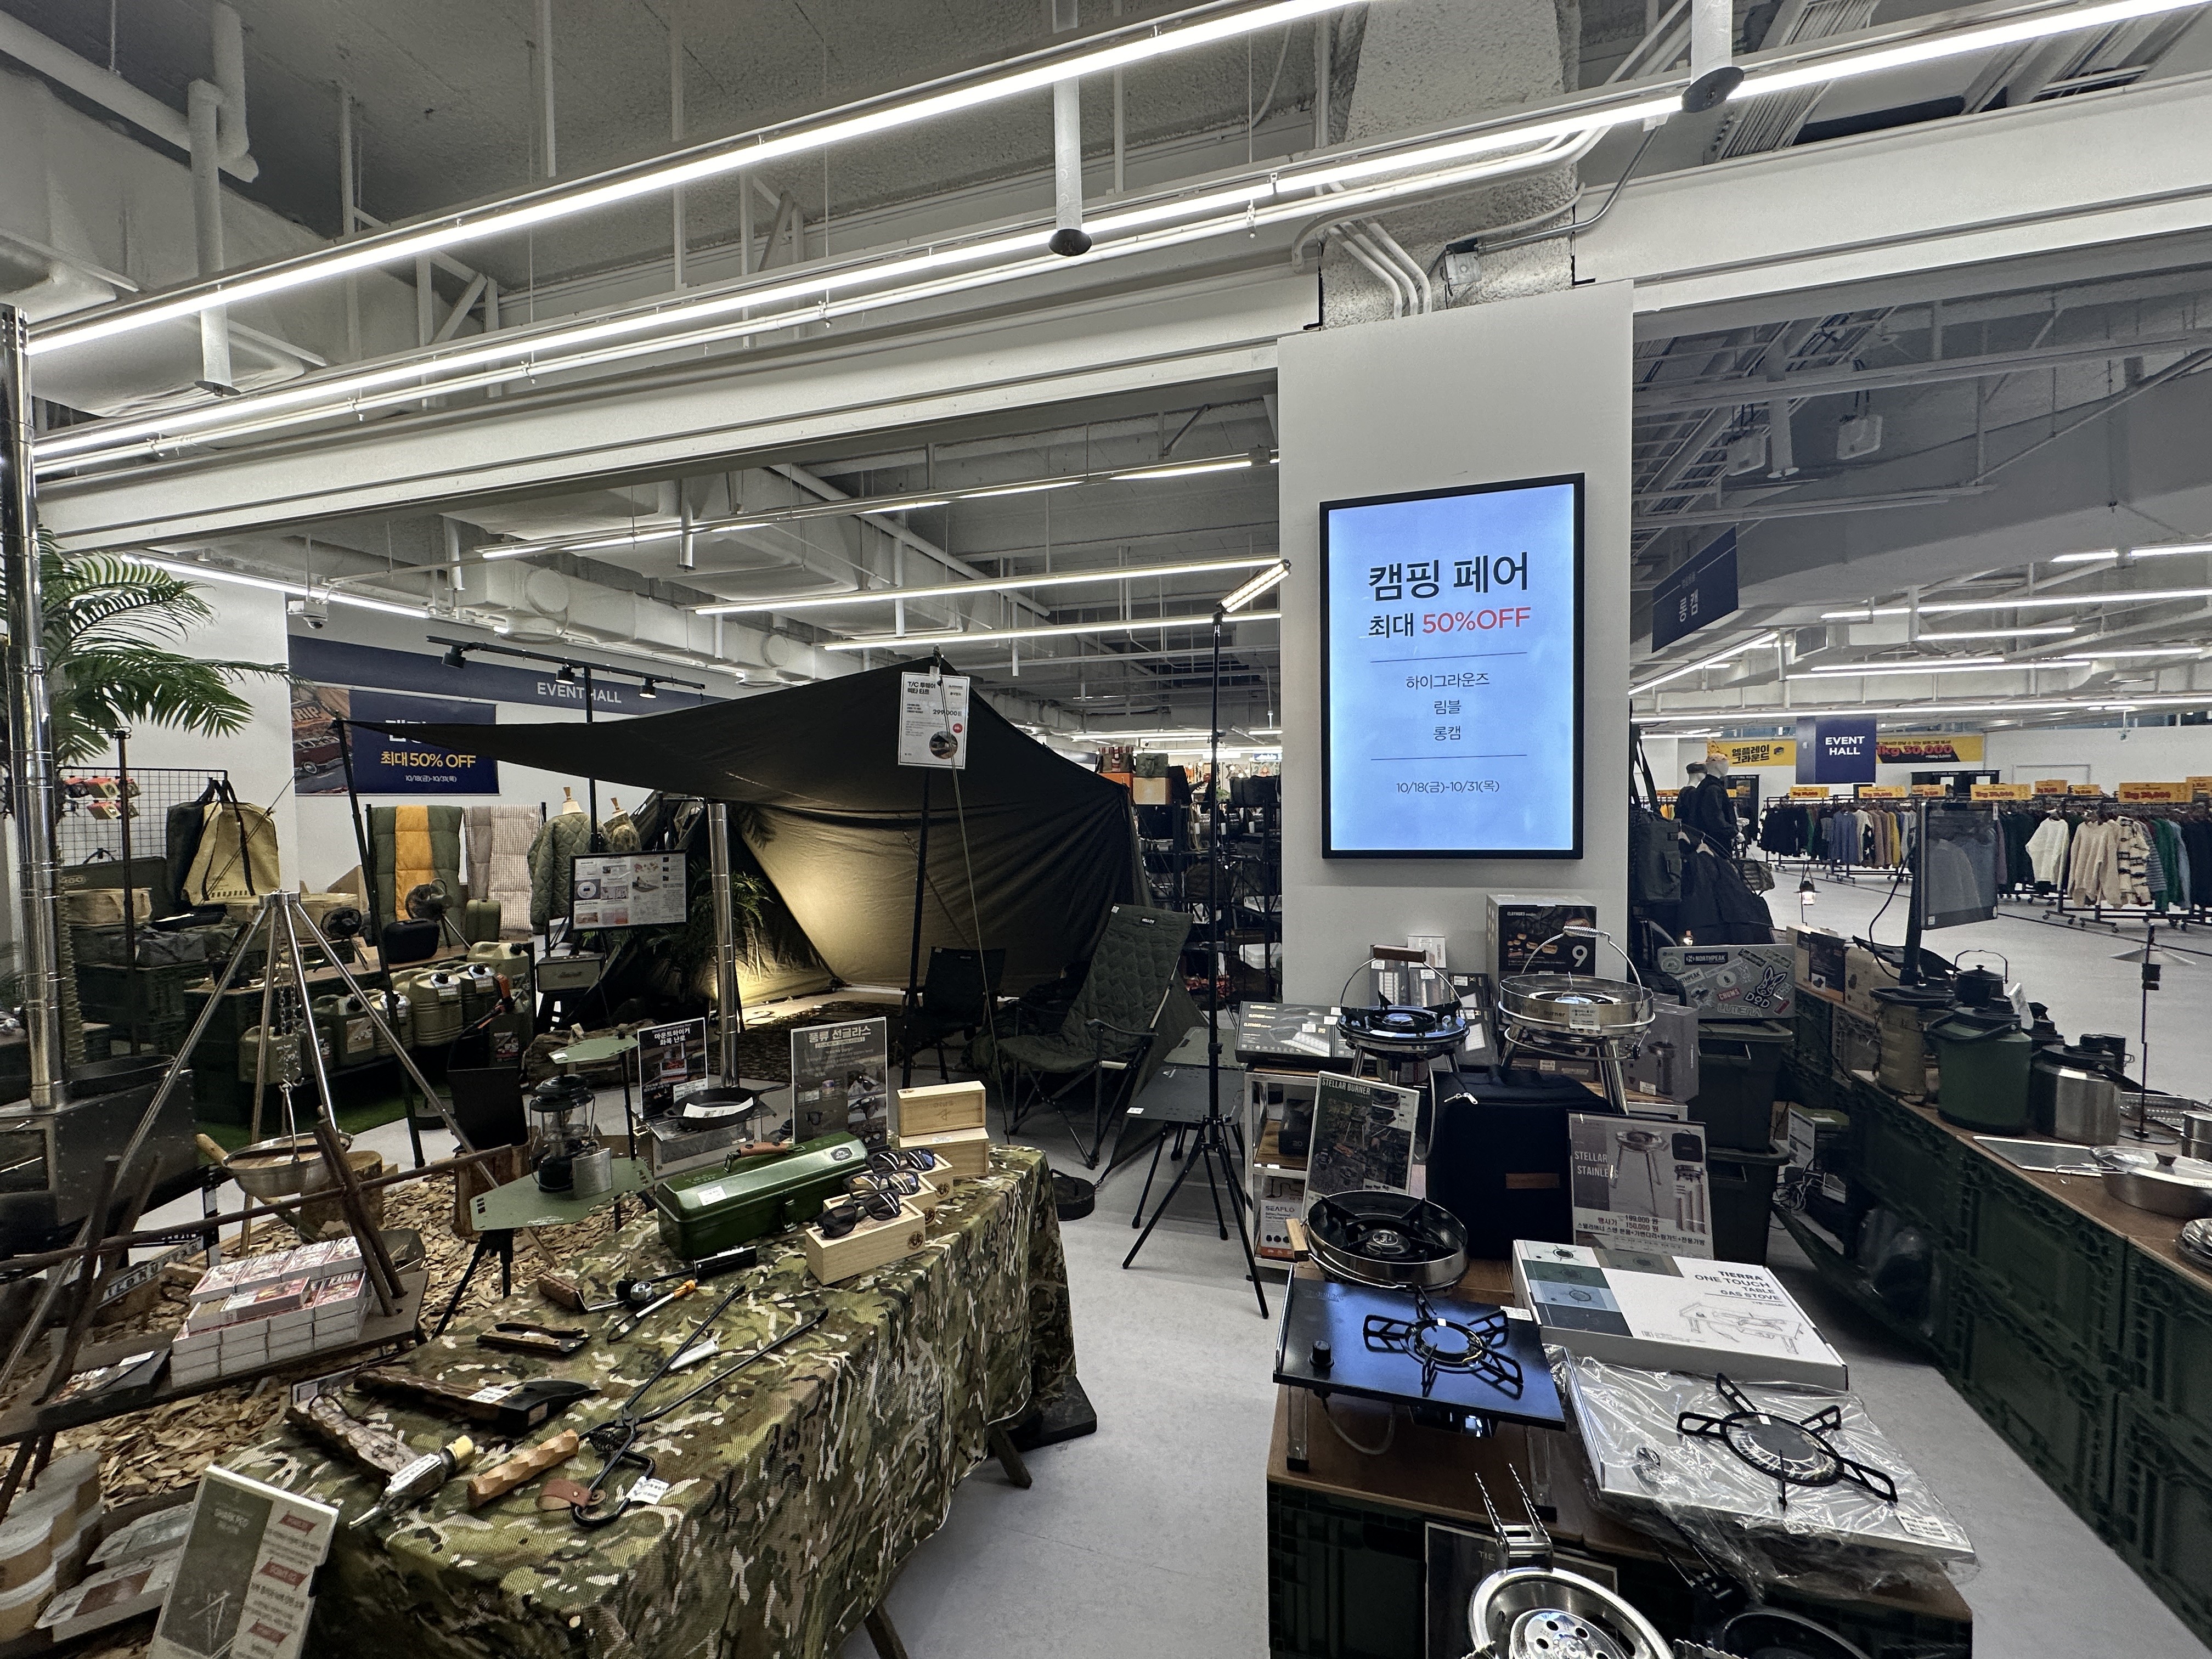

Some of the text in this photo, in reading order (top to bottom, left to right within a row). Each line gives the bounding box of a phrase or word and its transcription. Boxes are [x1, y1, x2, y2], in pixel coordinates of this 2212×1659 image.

[1368, 552, 1529, 602] 캠핑 페어
[1368, 607, 1531, 639] 최대 50%OFF
[1406, 672, 1490, 690] 하이그라운즈
[537, 682, 585, 699] EVENT
[292, 706, 320, 722] RIP
[1433, 700, 1462, 715] 림블
[1432, 725, 1462, 741] 롱캠
[1825, 736, 1865, 746] EVENT
[1829, 747, 1861, 755] HALL
[381, 751, 476, 768] 최대 50% OFF
[1732, 753, 1769, 764] 그라운드
[1396, 779, 1500, 794] 10/18(금)~10/31(목)
[1572, 945, 1588, 967] 9
[1679, 972, 1701, 984] RTHPEAK
[1718, 989, 1740, 1001] CHUMS
[654, 1027, 690, 1040] 마운트하이커
[674, 1035, 686, 1043] 난로
[809, 1031, 829, 1043] 풍류
[832, 1025, 871, 1040] 선글라스
[1322, 1078, 1371, 1096] STELLAR BURNER
[1574, 1151, 1607, 1163] STELLAR
[1577, 1165, 1618, 1179] STAINLES
[1695, 1274, 1771, 1288] ONE TOUCH
[1718, 1271, 1763, 1281] TIERRA
[1744, 1293, 1781, 1301] STOVE
